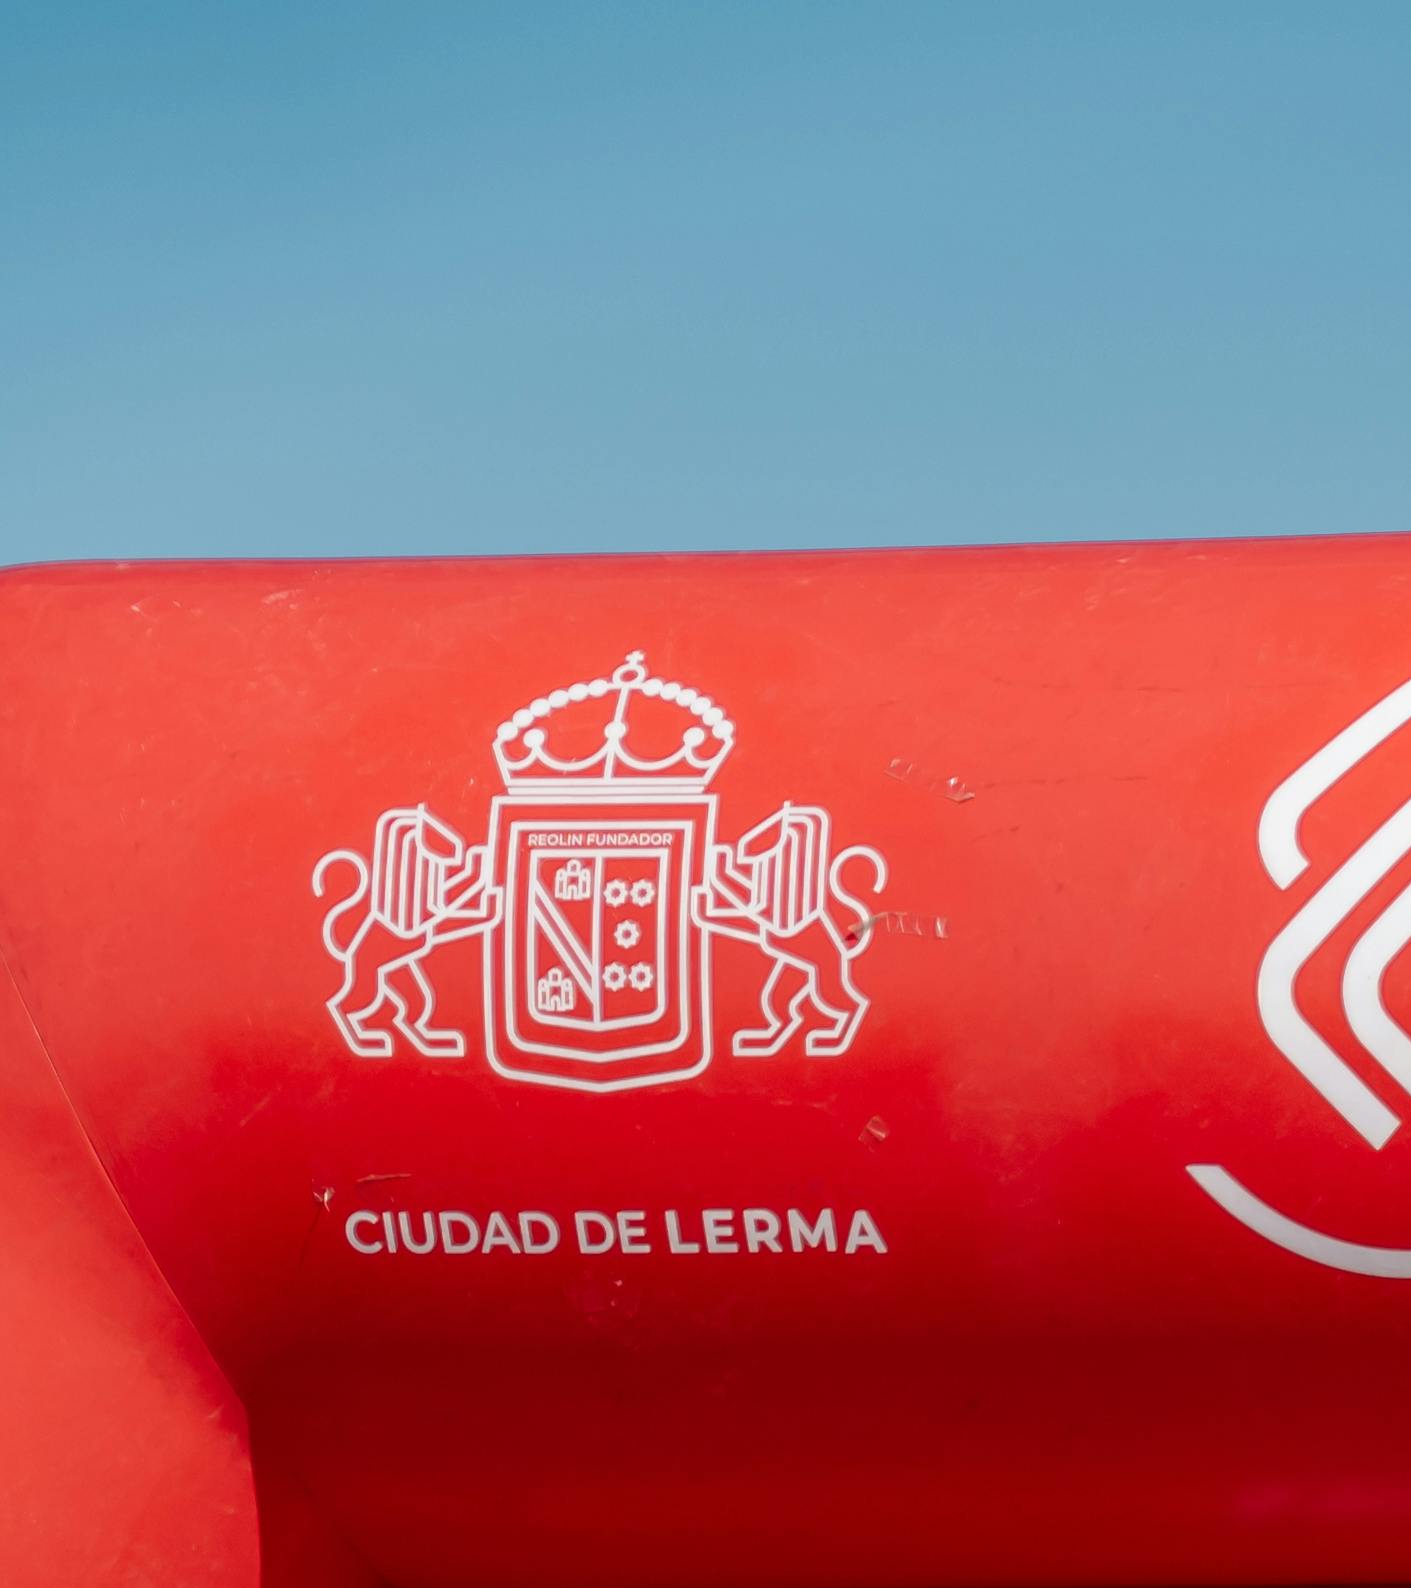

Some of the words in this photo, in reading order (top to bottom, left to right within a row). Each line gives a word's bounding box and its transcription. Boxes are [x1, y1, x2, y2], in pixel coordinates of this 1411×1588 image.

[528, 833, 582, 846] REOLIN
[586, 832, 673, 846] FUNDADOR
[345, 1210, 560, 1254] CIUDAD
[574, 1210, 652, 1254] DE
[665, 1208, 888, 1254] LERMA
